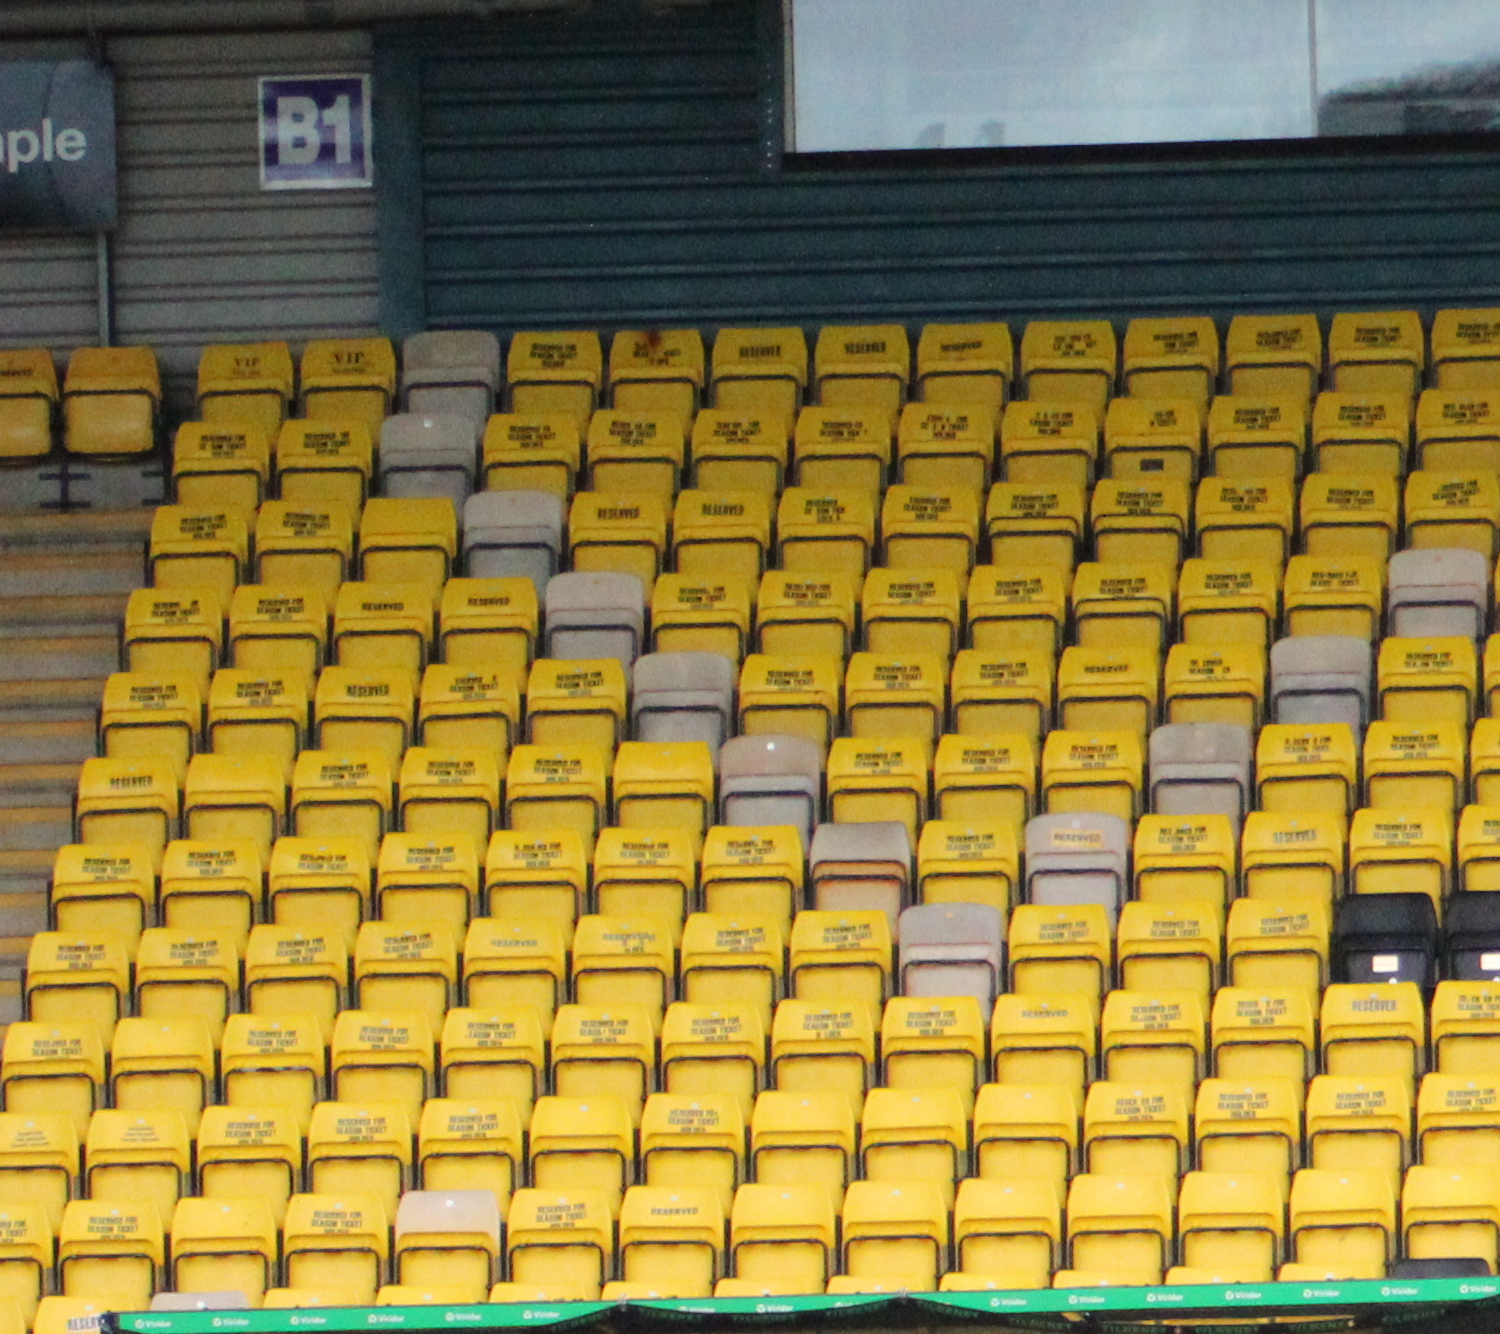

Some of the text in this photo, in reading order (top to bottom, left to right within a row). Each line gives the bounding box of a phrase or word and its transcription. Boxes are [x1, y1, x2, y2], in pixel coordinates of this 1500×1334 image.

[276, 93, 352, 166] B1
[362, 603, 404, 611] RESERVED
[468, 597, 509, 606] RESERVED
[347, 685, 389, 697] RESERVED
[110, 775, 152, 789] RESERVED
[1352, 1000, 1396, 1011] RESERVED
[651, 1207, 698, 1215] RESERVED
